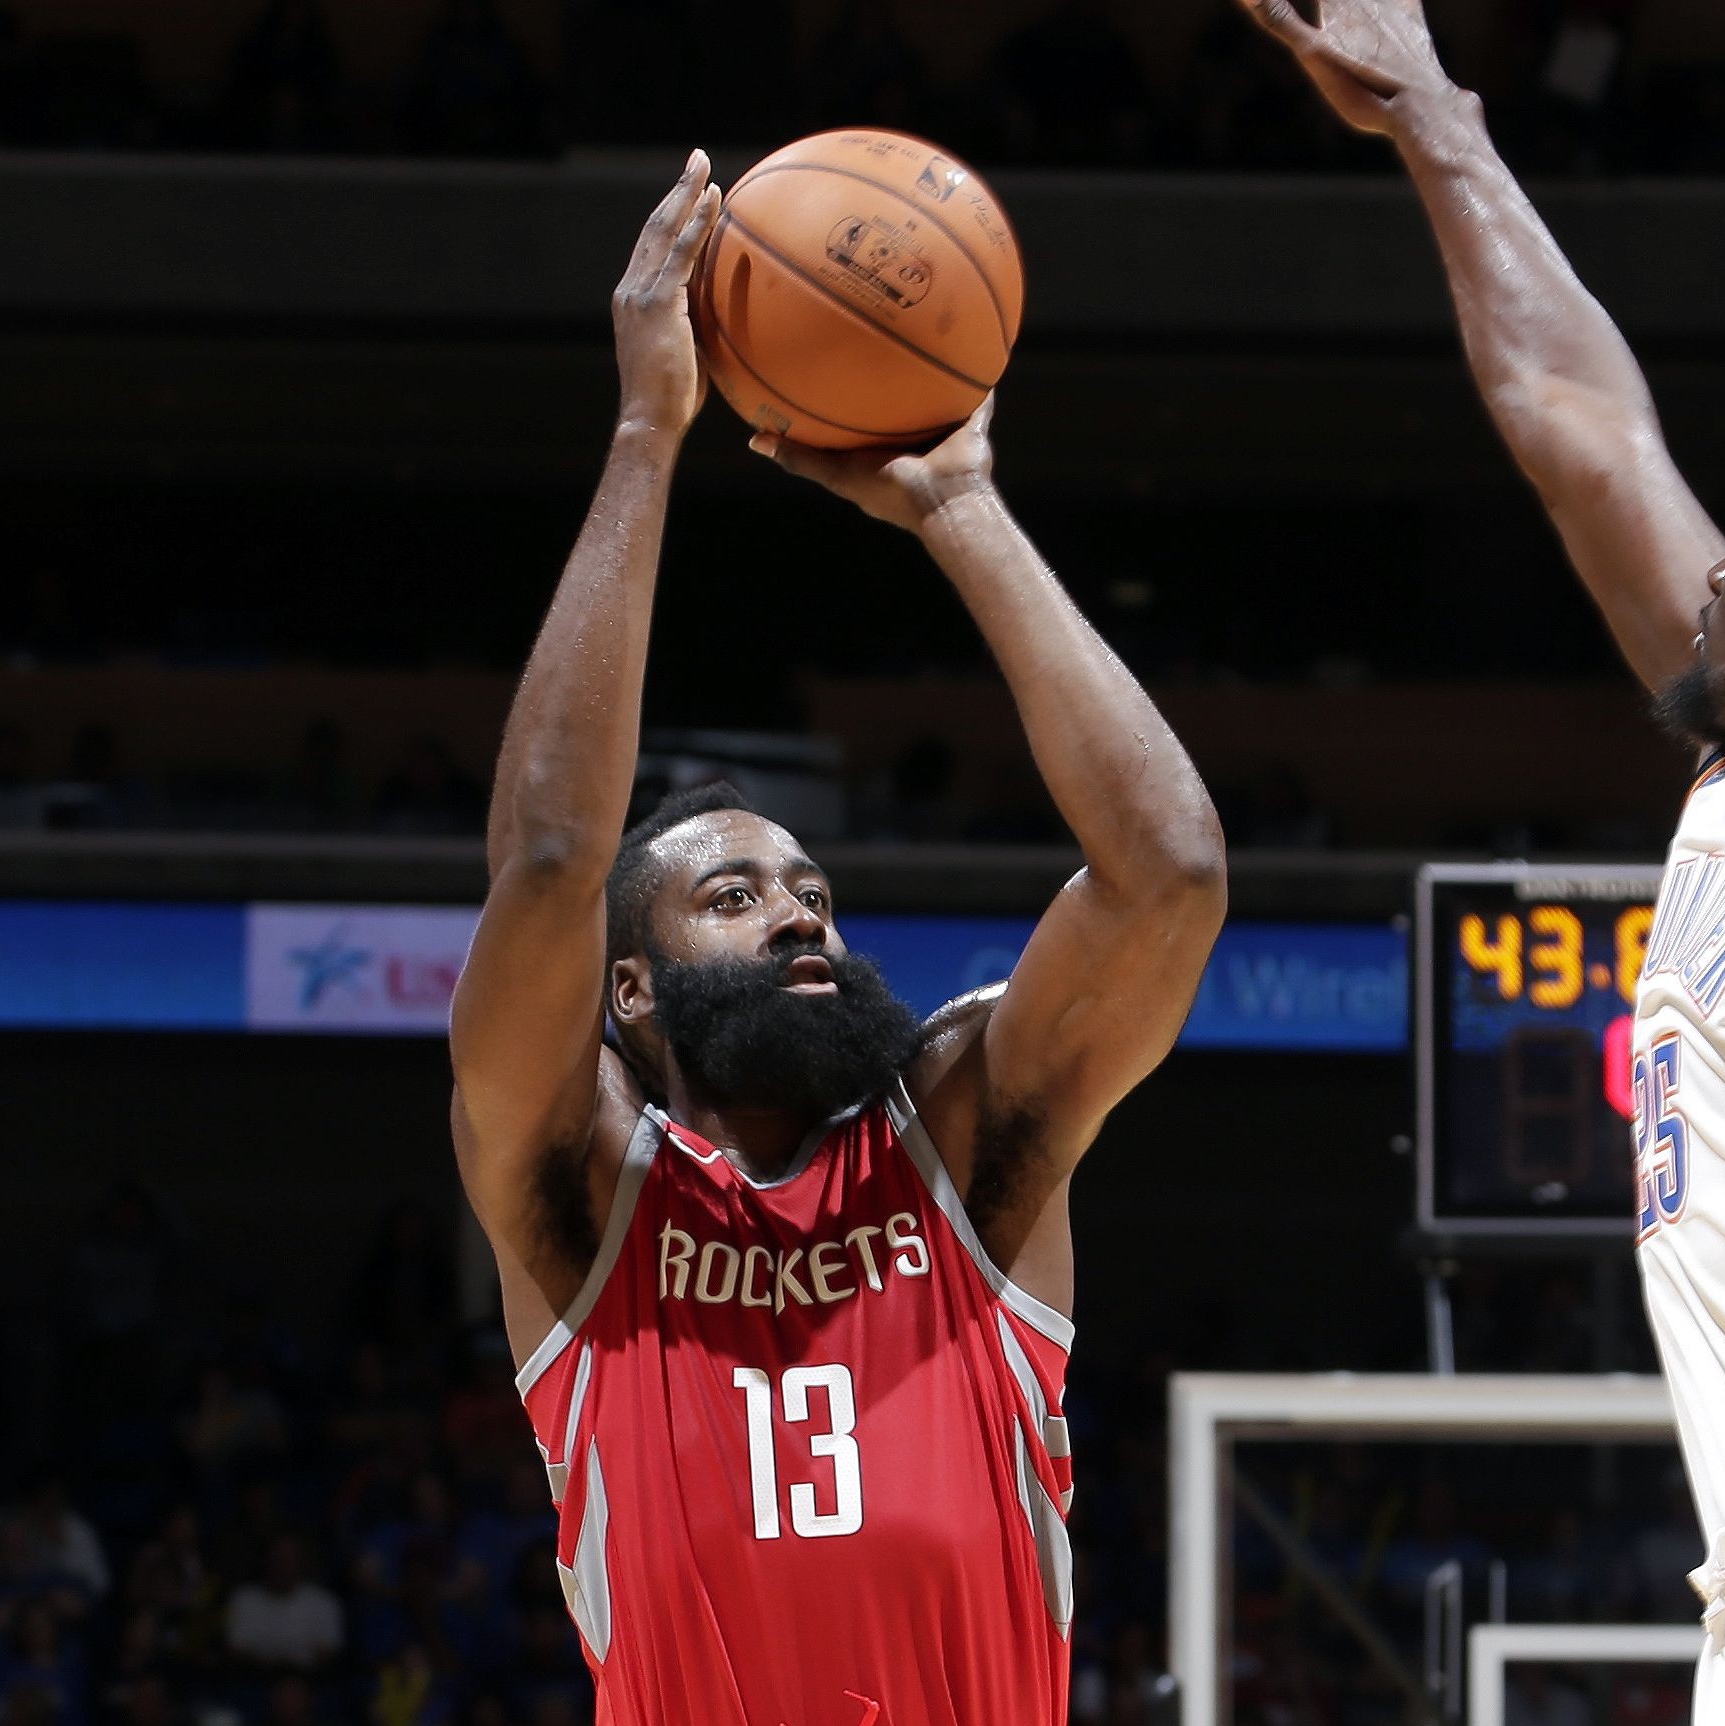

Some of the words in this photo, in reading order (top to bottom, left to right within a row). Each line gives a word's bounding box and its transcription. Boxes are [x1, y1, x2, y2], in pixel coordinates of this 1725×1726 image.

[1633, 1031, 1690, 1247] 25
[658, 1211, 931, 1315] ROCKETS
[733, 1362, 864, 1540] 13
